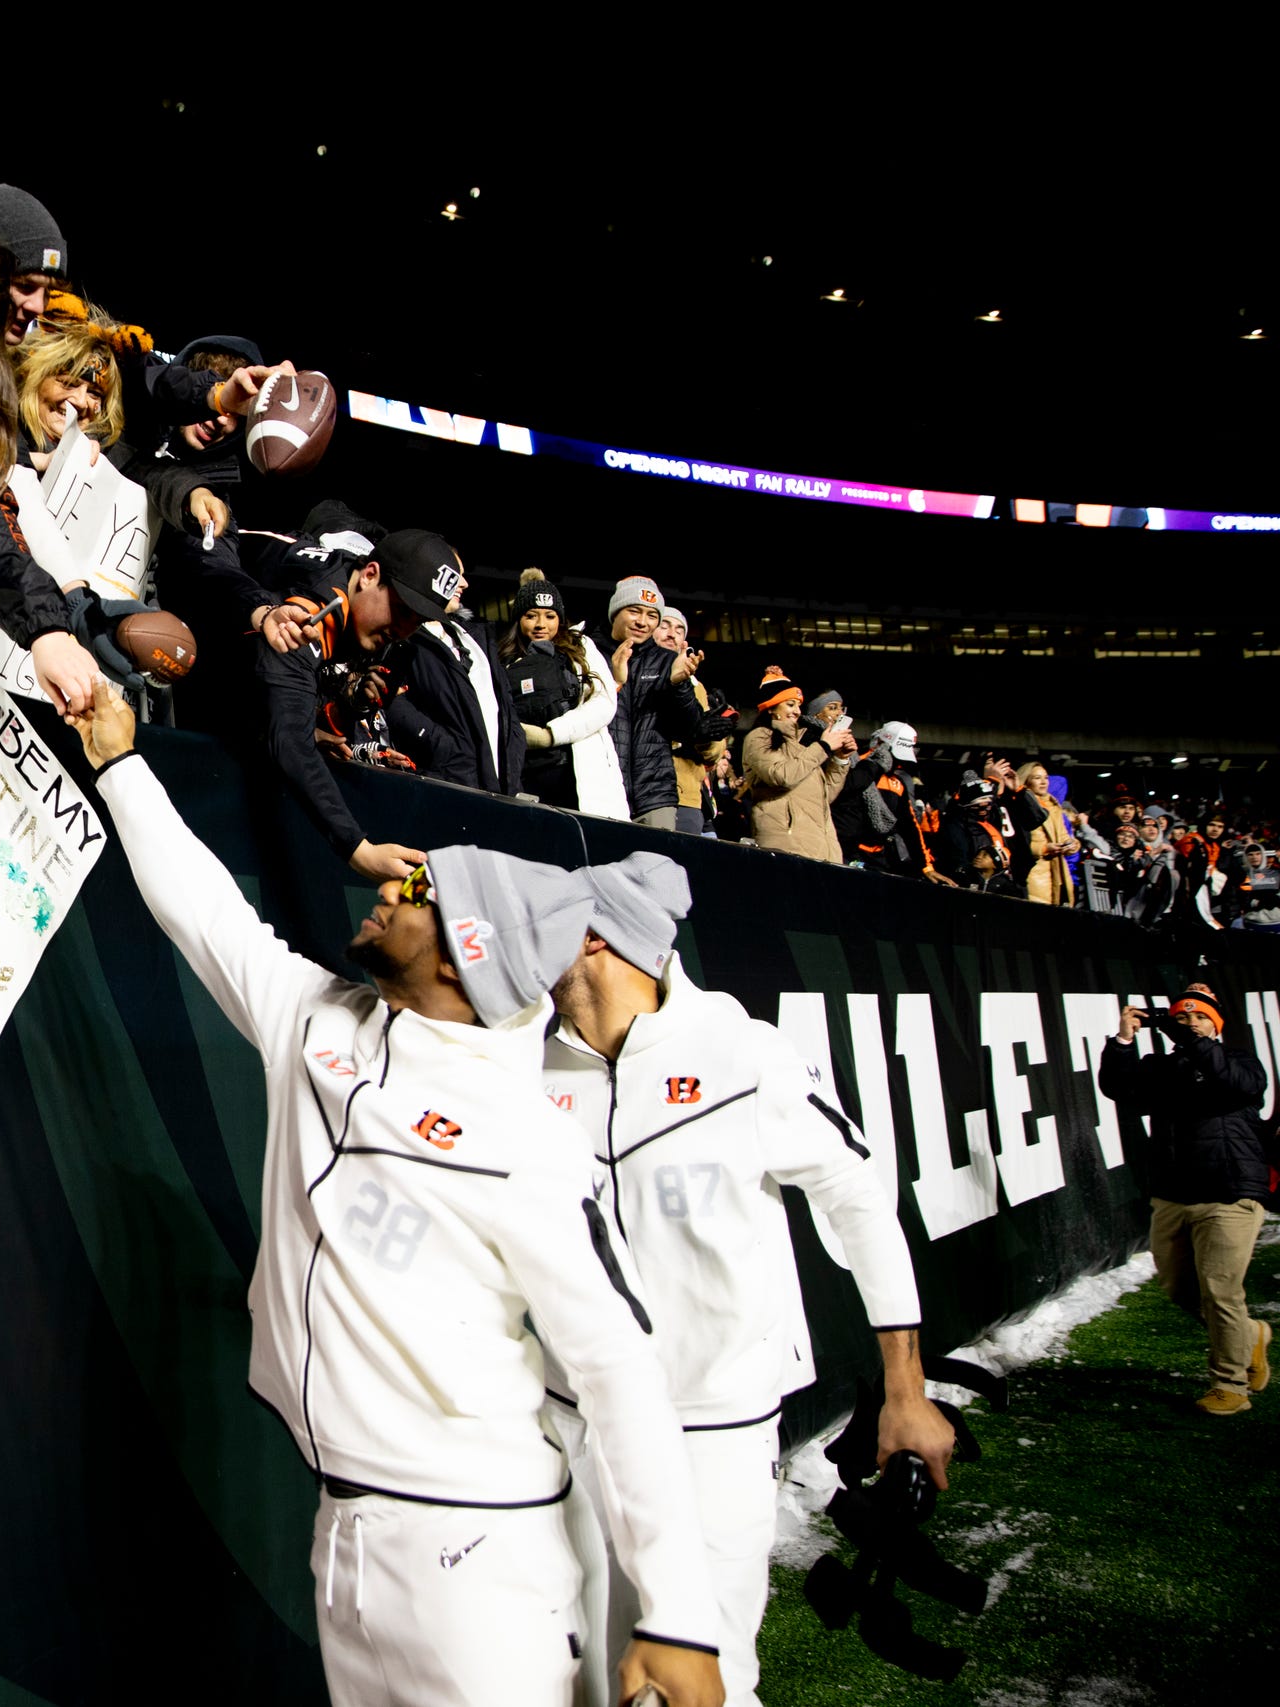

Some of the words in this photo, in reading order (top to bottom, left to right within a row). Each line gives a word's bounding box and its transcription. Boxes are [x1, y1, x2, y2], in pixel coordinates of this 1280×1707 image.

[604, 449, 690, 479] OPENING
[692, 464, 749, 488] NIGHT
[755, 473, 782, 493] FAN
[785, 478, 831, 498] RALLY
[841, 487, 889, 501] PRESENTED
[890, 493, 902, 503] BY
[41, 774, 102, 852] MY
[777, 991, 1066, 1272] ULE
[342, 1180, 431, 1272] 28
[654, 1163, 721, 1218] 87
